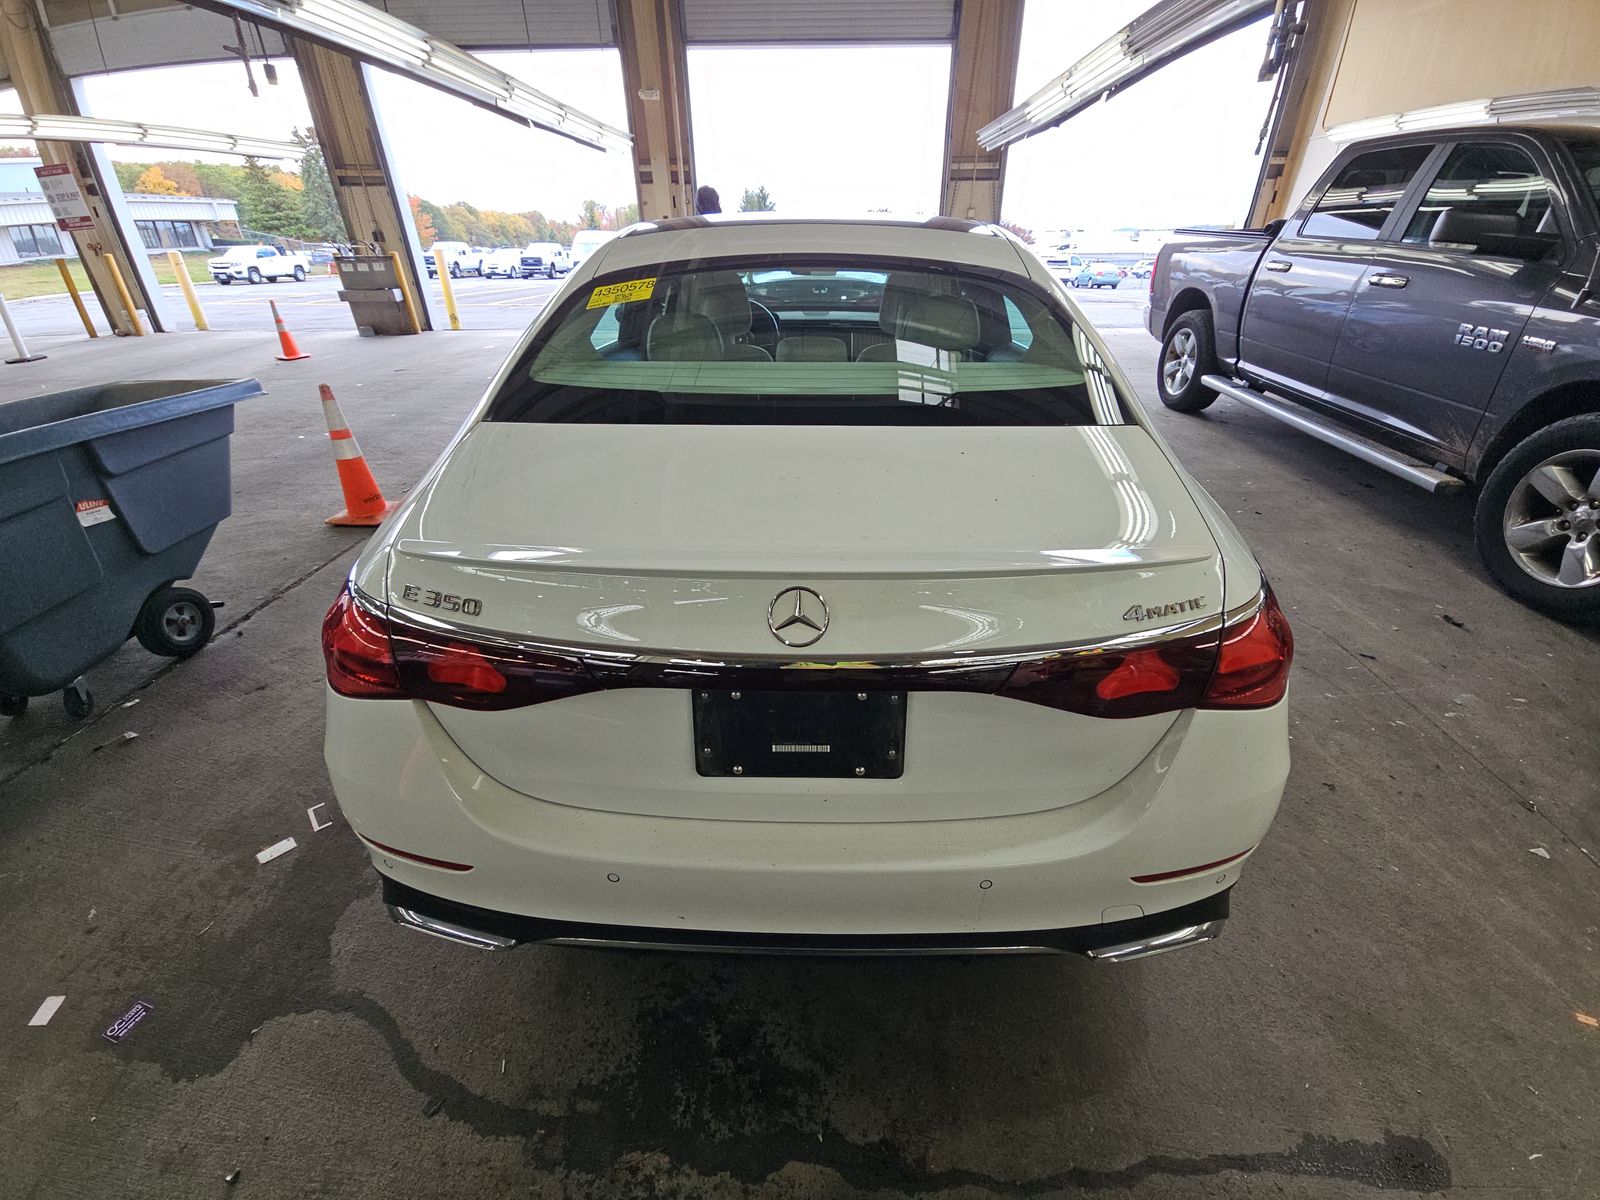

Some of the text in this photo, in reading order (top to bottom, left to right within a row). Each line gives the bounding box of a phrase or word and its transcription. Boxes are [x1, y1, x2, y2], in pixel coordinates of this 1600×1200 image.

[594, 280, 656, 297] 4350578
[1458, 322, 1510, 342] RAM
[1454, 333, 1504, 354] 1500
[402, 583, 482, 616] E 350
[1122, 595, 1208, 622] 4MATIC
